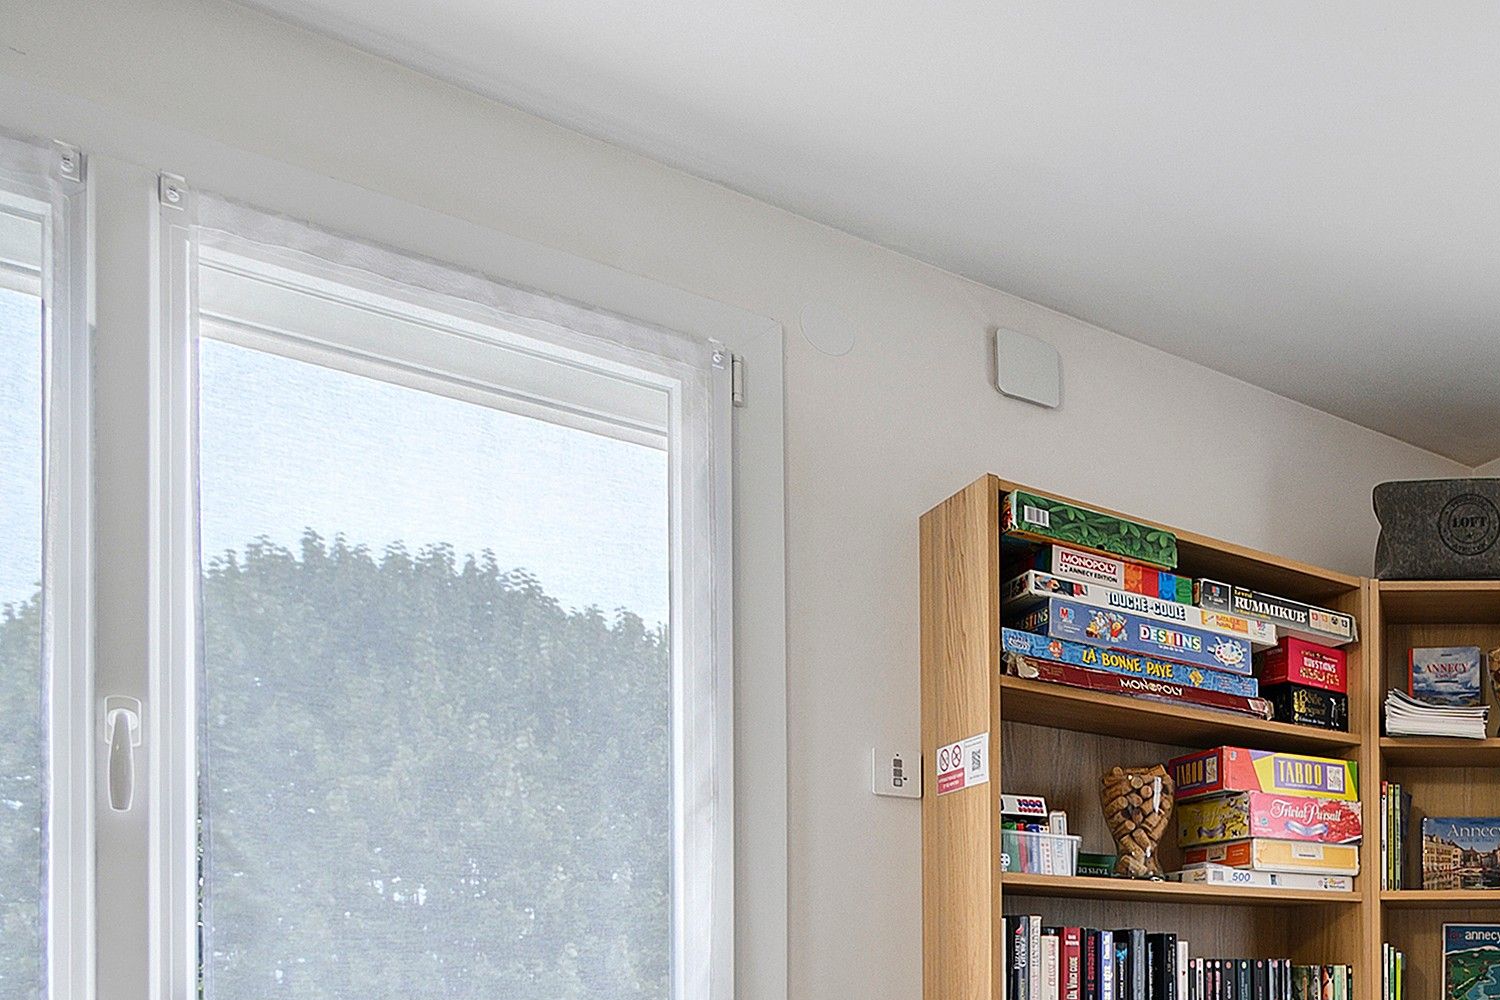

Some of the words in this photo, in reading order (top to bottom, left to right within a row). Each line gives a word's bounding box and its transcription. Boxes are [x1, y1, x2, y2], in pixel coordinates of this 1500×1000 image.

[1061, 552, 1117, 575] MONOPOLY
[1069, 566, 1093, 578] ANNECY
[1094, 571, 1118, 584] EDITION
[1234, 596, 1306, 623] RUMMIKUB
[1140, 624, 1201, 651] DESTINS
[1082, 649, 1097, 664] LA
[1102, 652, 1141, 671] BONNE
[1146, 660, 1174, 678] PAYE
[1424, 662, 1470, 673] ANNECY
[1119, 678, 1183, 696] MONOPOLY
[1175, 760, 1204, 787] TABOO
[1279, 759, 1322, 786] TABOO
[1270, 799, 1306, 818] Trivial
[1306, 801, 1342, 823] Pursuit
[1231, 872, 1251, 882] 500
